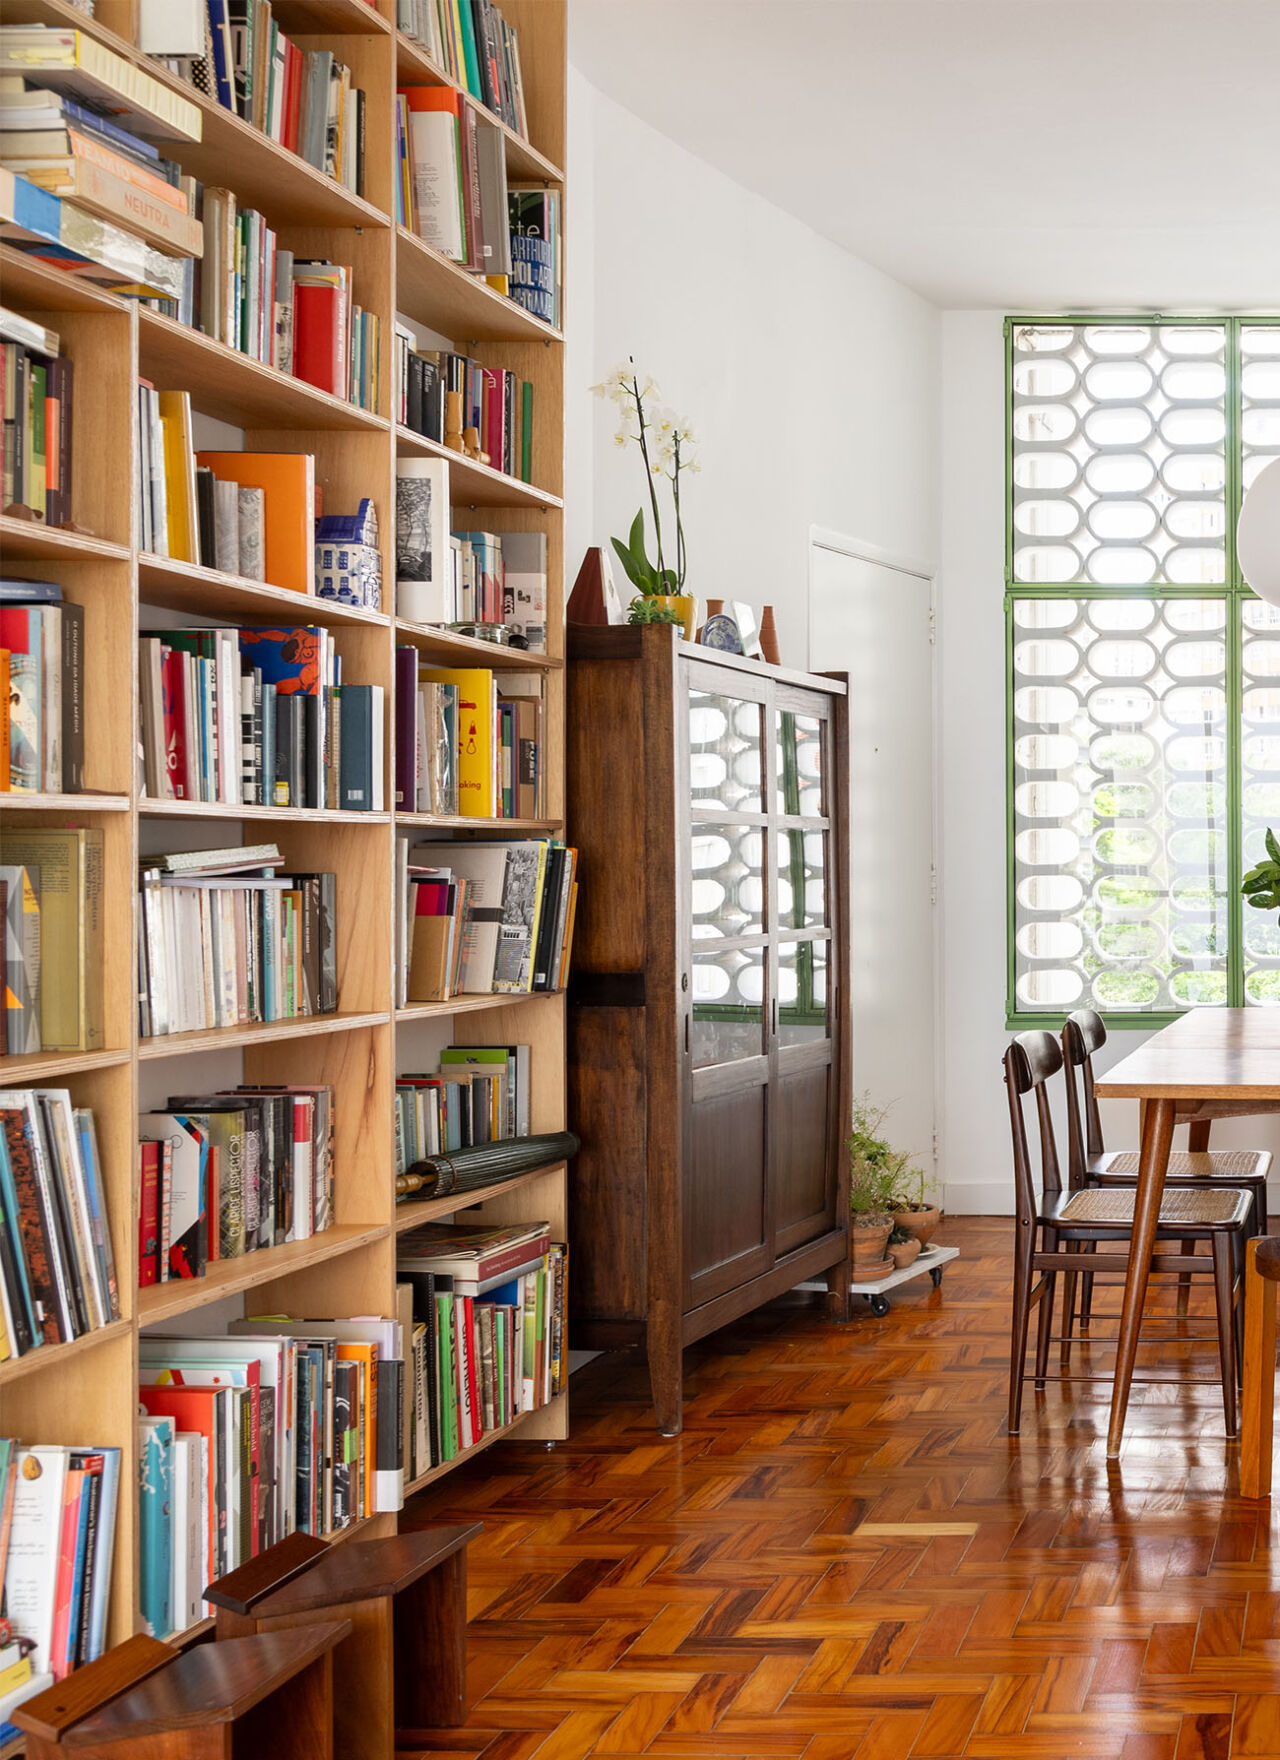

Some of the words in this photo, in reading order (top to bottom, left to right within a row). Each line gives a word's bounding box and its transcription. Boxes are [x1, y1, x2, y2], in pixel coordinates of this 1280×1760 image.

[123, 191, 170, 228] NEUTRA
[265, 873, 274, 921] CAETAO
[229, 1134, 241, 1193] LISPECTOR
[246, 1129, 259, 1190] LISPECTOR
[229, 1193, 241, 1237] CLARICE
[246, 1191, 257, 1232] CLARICE
[416, 1338, 424, 1422] PRODUCTION
[250, 1400, 258, 1452] Tschichold
[88, 1475, 98, 1528] Boatowner's
[85, 1528, 95, 1575] Mechanical
[84, 1575, 92, 1592] and
[82, 1592, 91, 1629] Electrical
[80, 1630, 89, 1661] Manual
